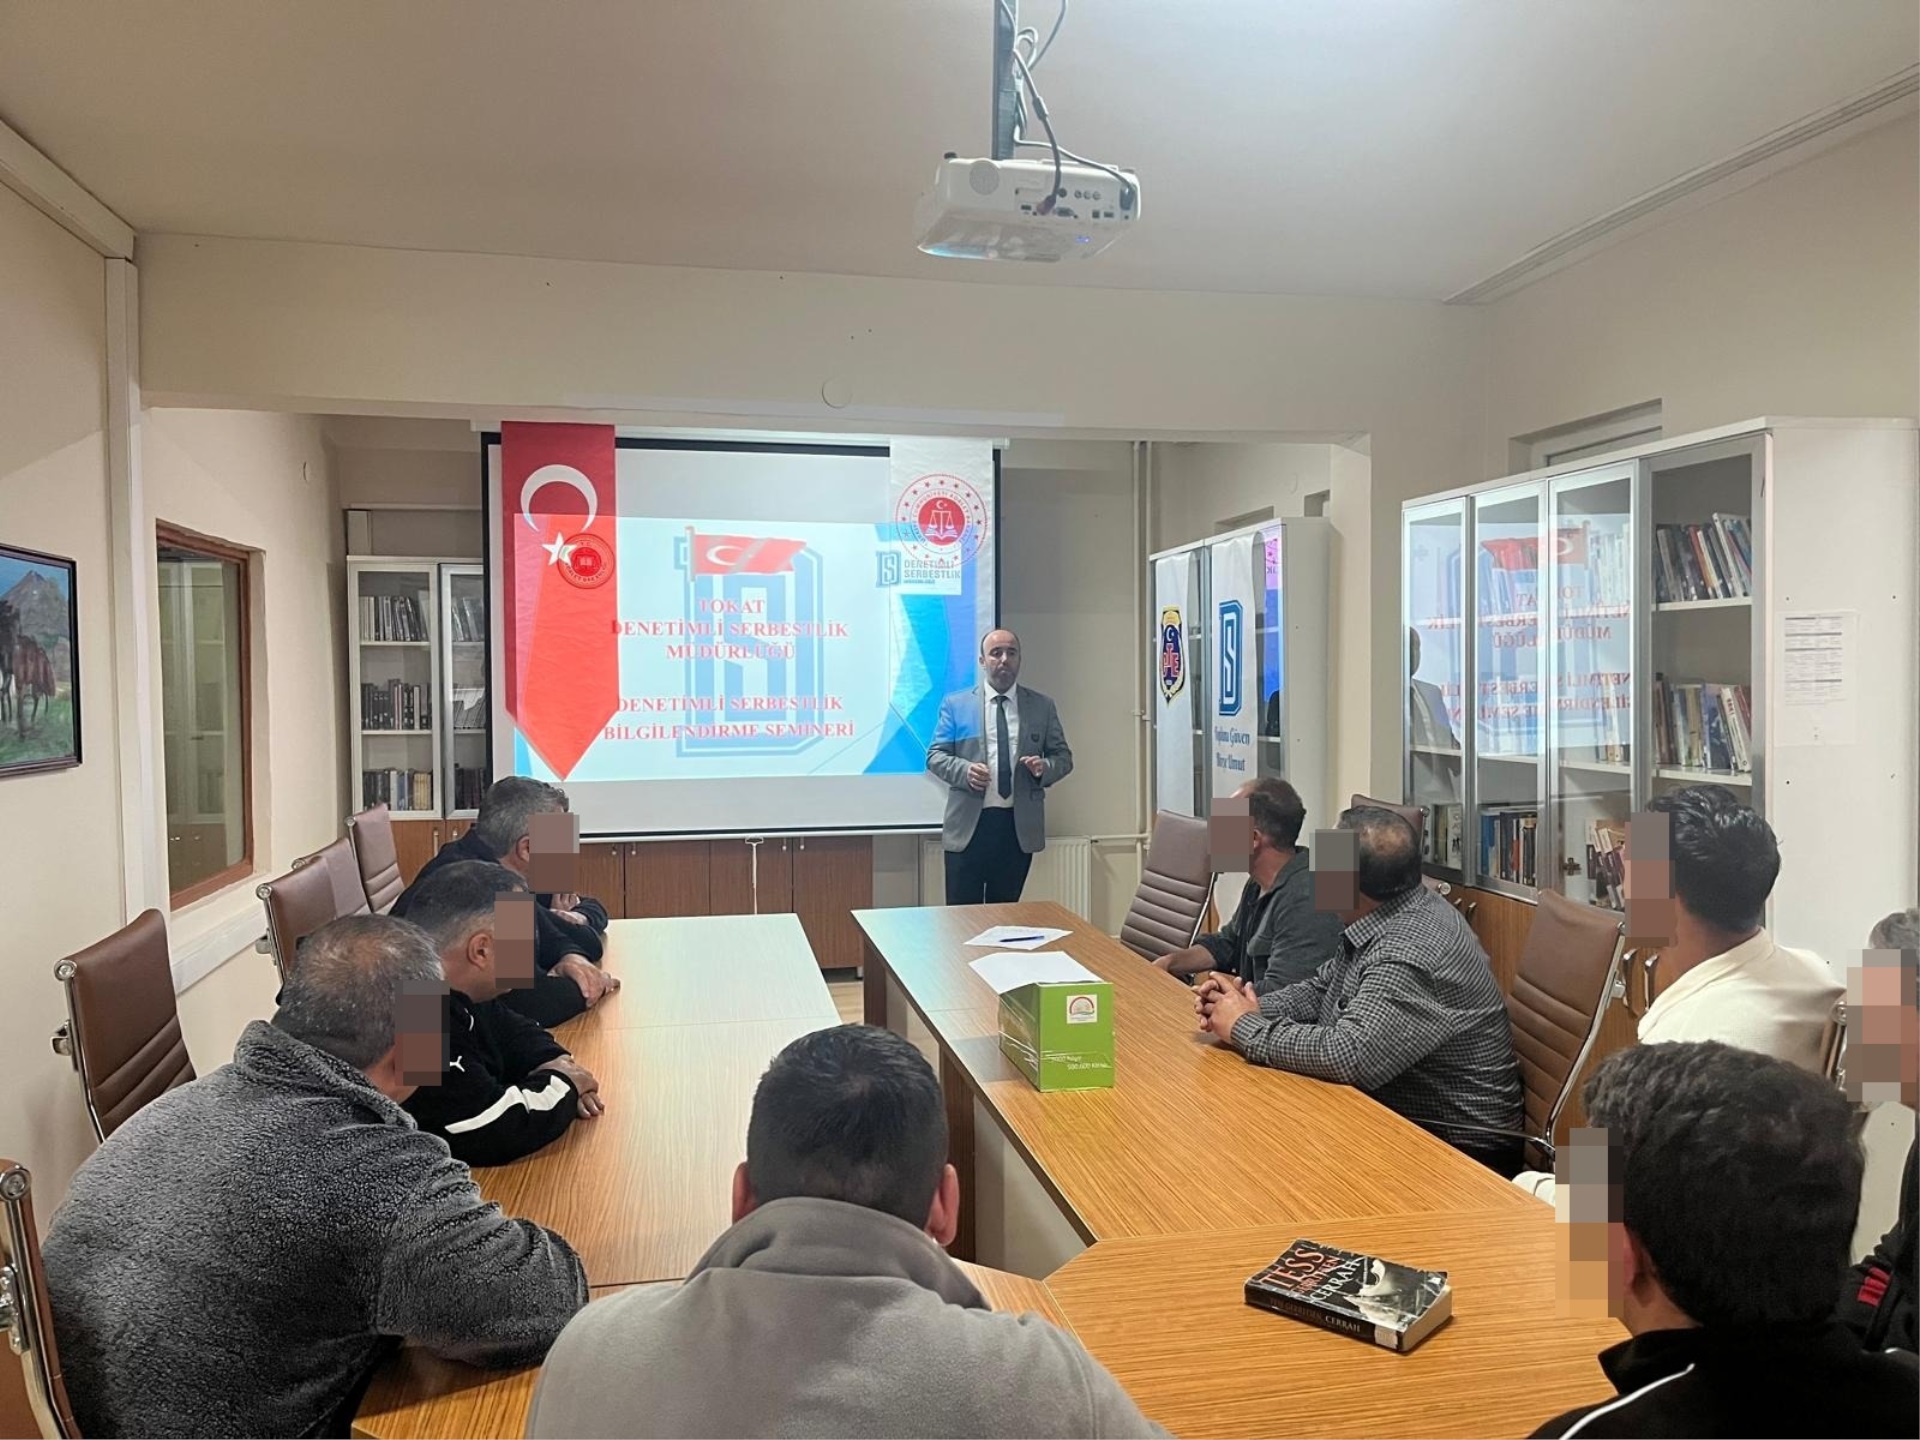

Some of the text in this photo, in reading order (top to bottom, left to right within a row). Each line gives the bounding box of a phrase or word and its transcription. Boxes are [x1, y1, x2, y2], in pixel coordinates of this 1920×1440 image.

[701, 599, 765, 614] TOKAT
[611, 619, 848, 637] DENETİMLİ SERBESTLİK
[666, 642, 795, 660] MÜDÜRLÜĞÜ
[619, 694, 843, 712] DENETİMLİ SERBESTLİK
[604, 719, 855, 740] BİLGİLENDİRME SEMİNERİ
[1260, 1247, 1325, 1289] TESS
[1310, 1257, 1362, 1303] CERRAH
[1325, 1315, 1360, 1332] CERRAH
